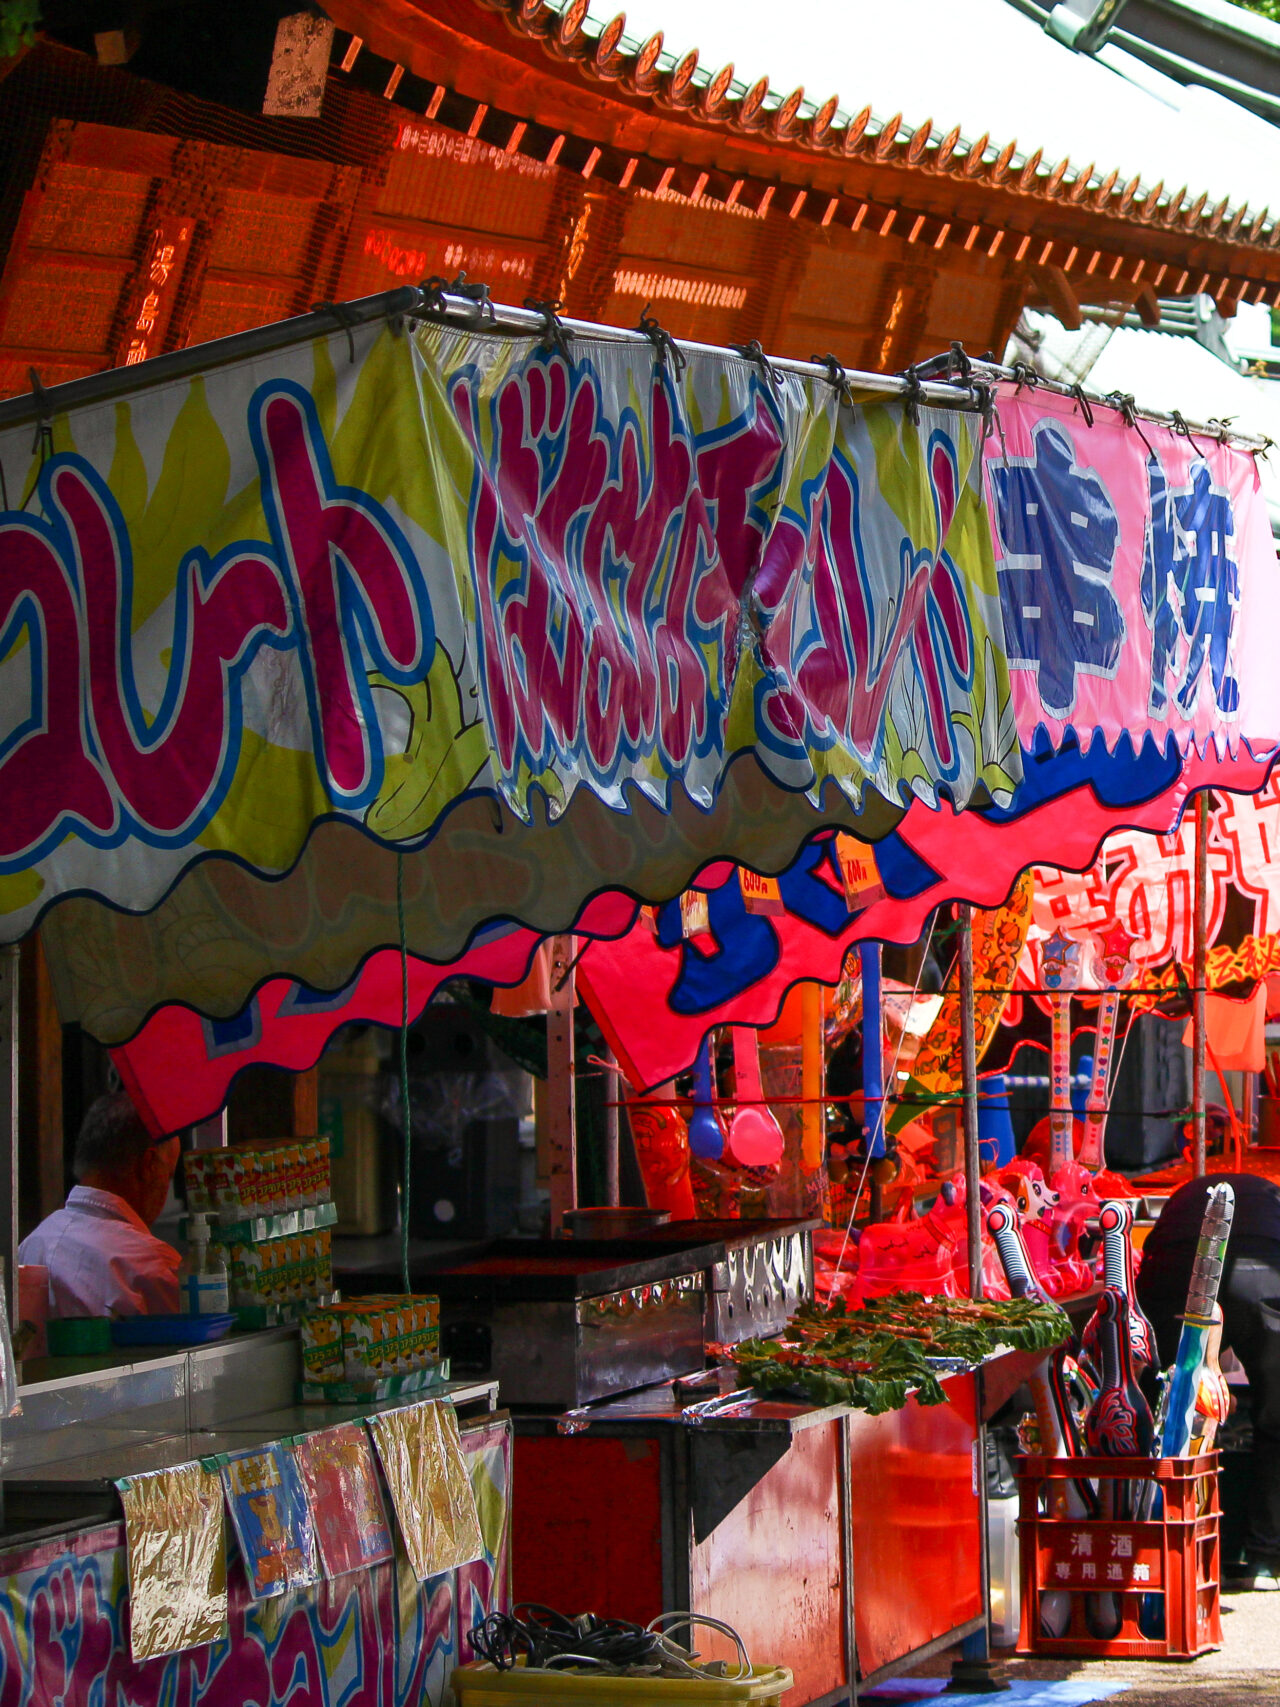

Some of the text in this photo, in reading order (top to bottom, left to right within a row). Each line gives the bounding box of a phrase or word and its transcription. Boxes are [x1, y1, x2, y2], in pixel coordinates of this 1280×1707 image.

[1070, 1532, 1133, 1557] 清酒
[1055, 1561, 1151, 1582] 専用通箱
